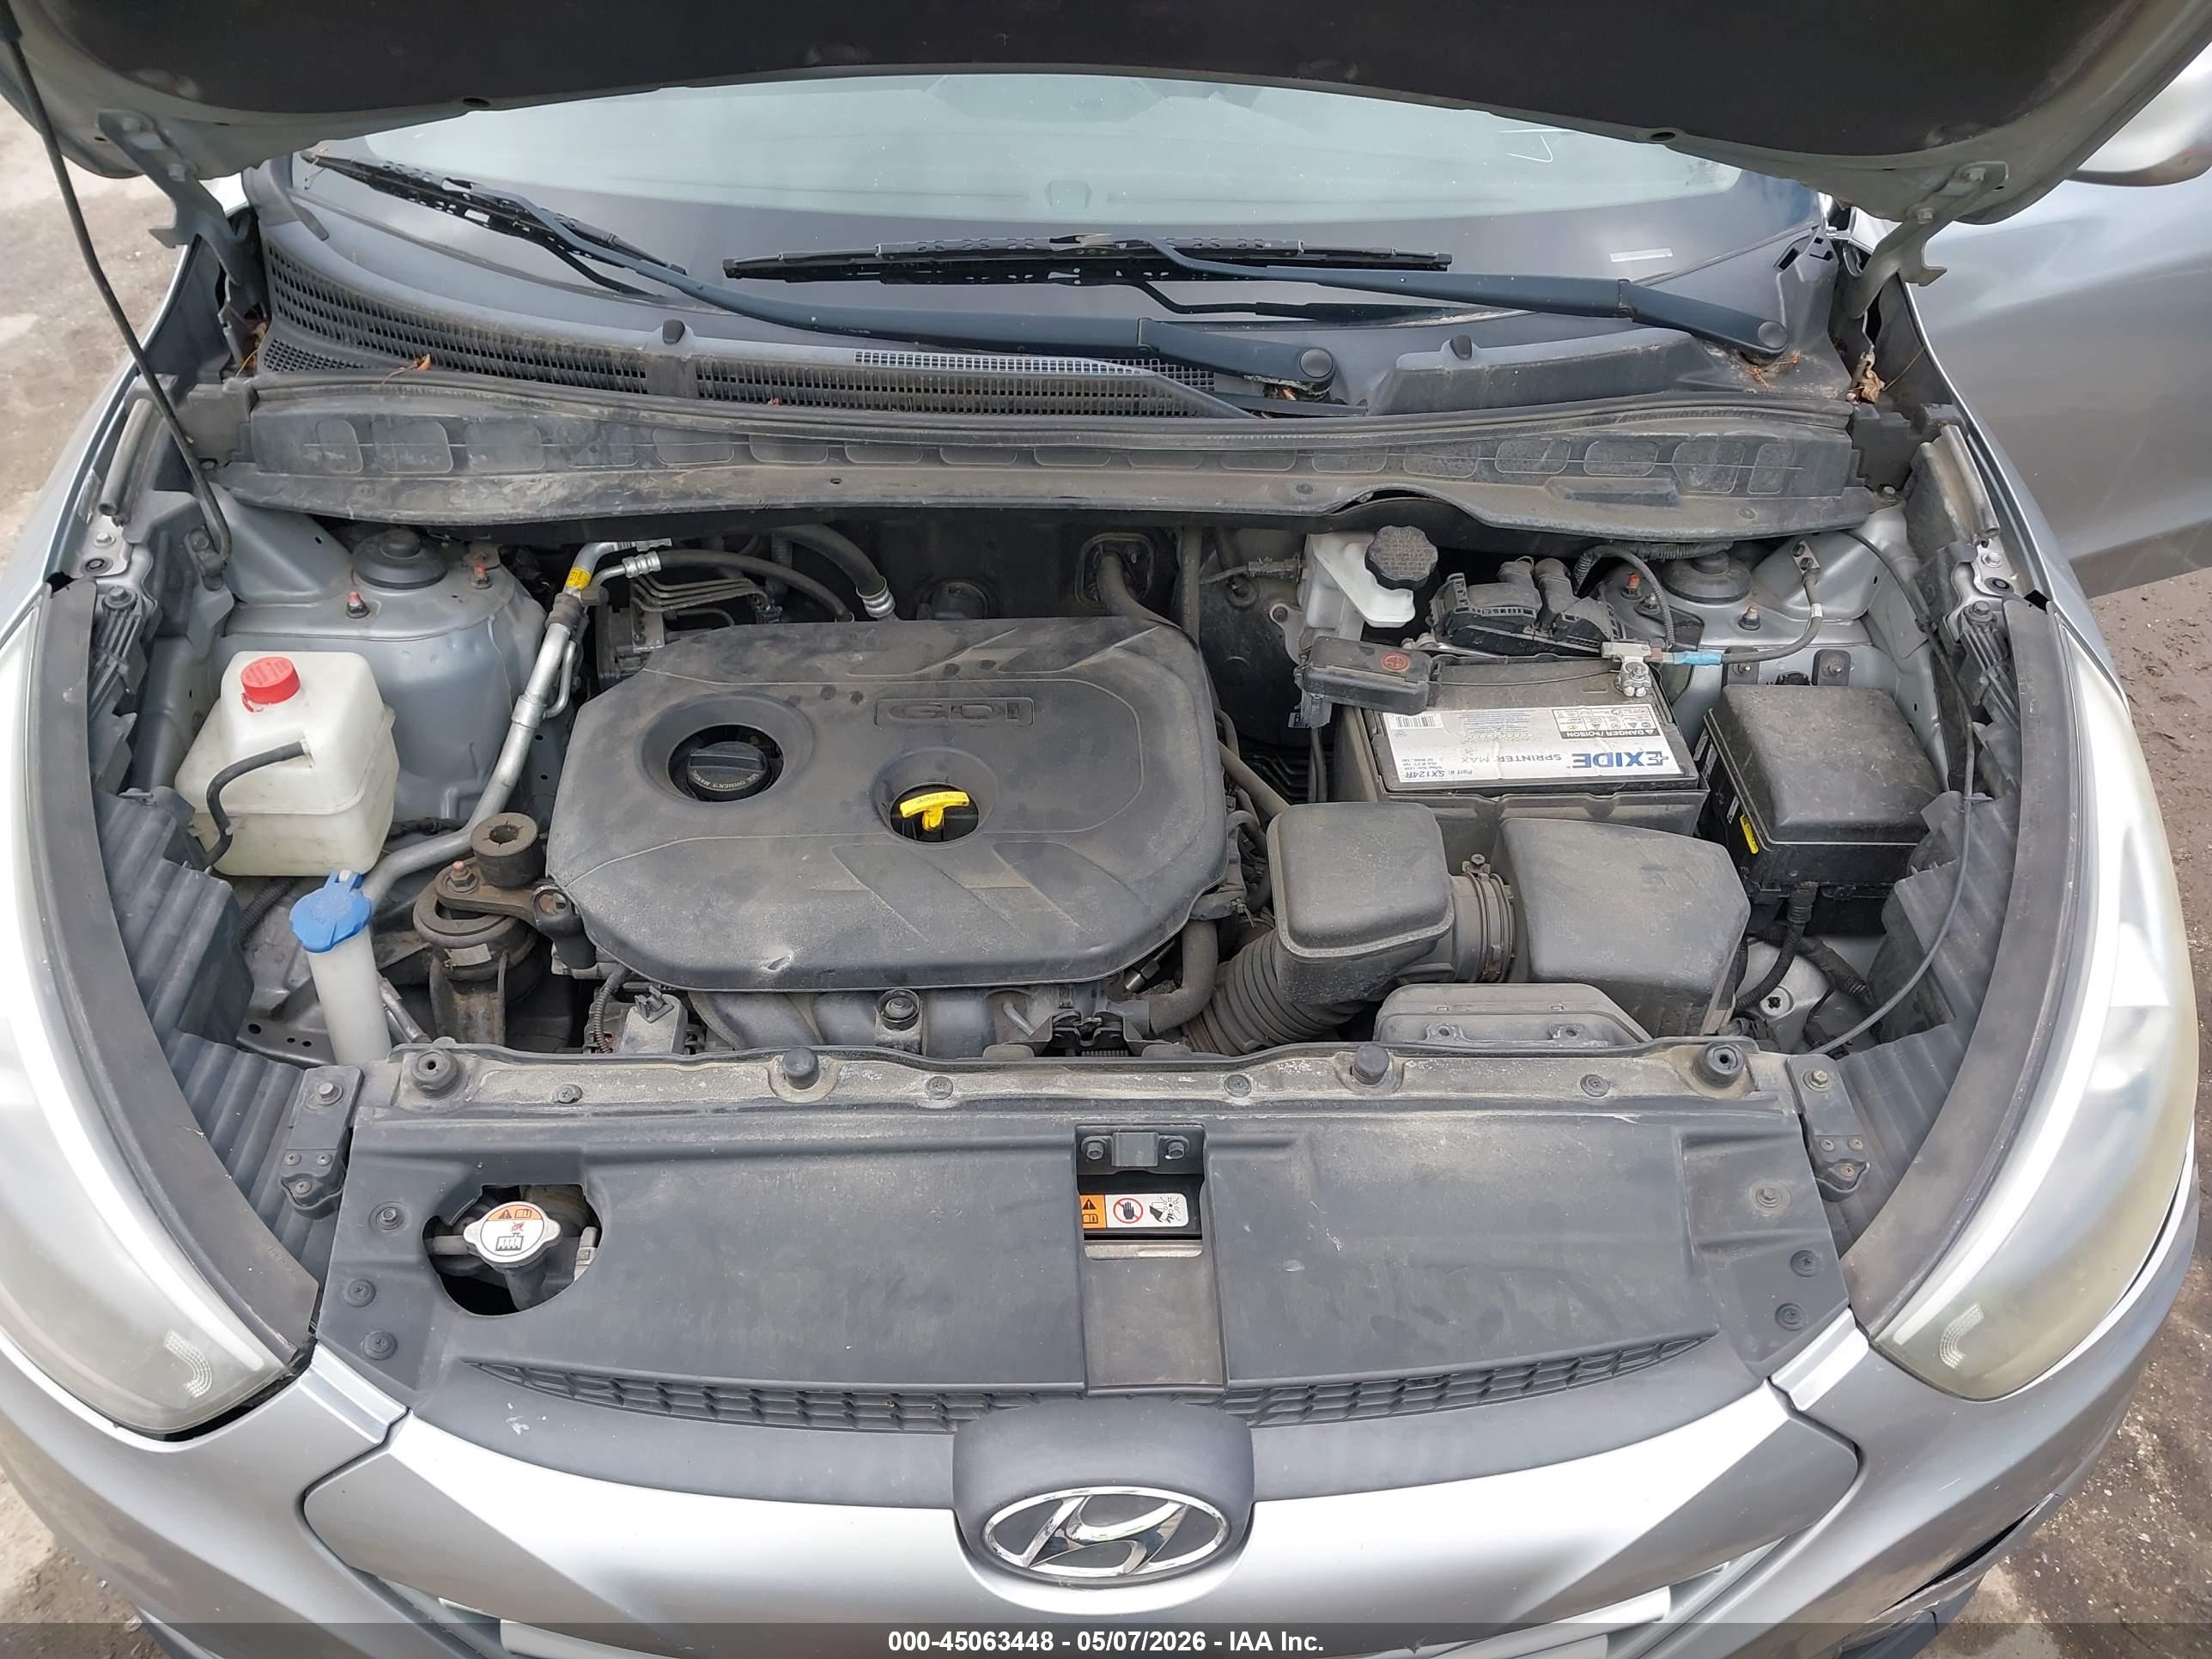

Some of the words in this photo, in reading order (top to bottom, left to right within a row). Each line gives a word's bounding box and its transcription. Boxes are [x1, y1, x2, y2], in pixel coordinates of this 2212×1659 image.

[889, 702, 1020, 721] GDI
[1497, 753, 1563, 763] SPRINTER
[1571, 750, 1669, 769] EXIDE
[1404, 769, 1445, 779] SX124R
